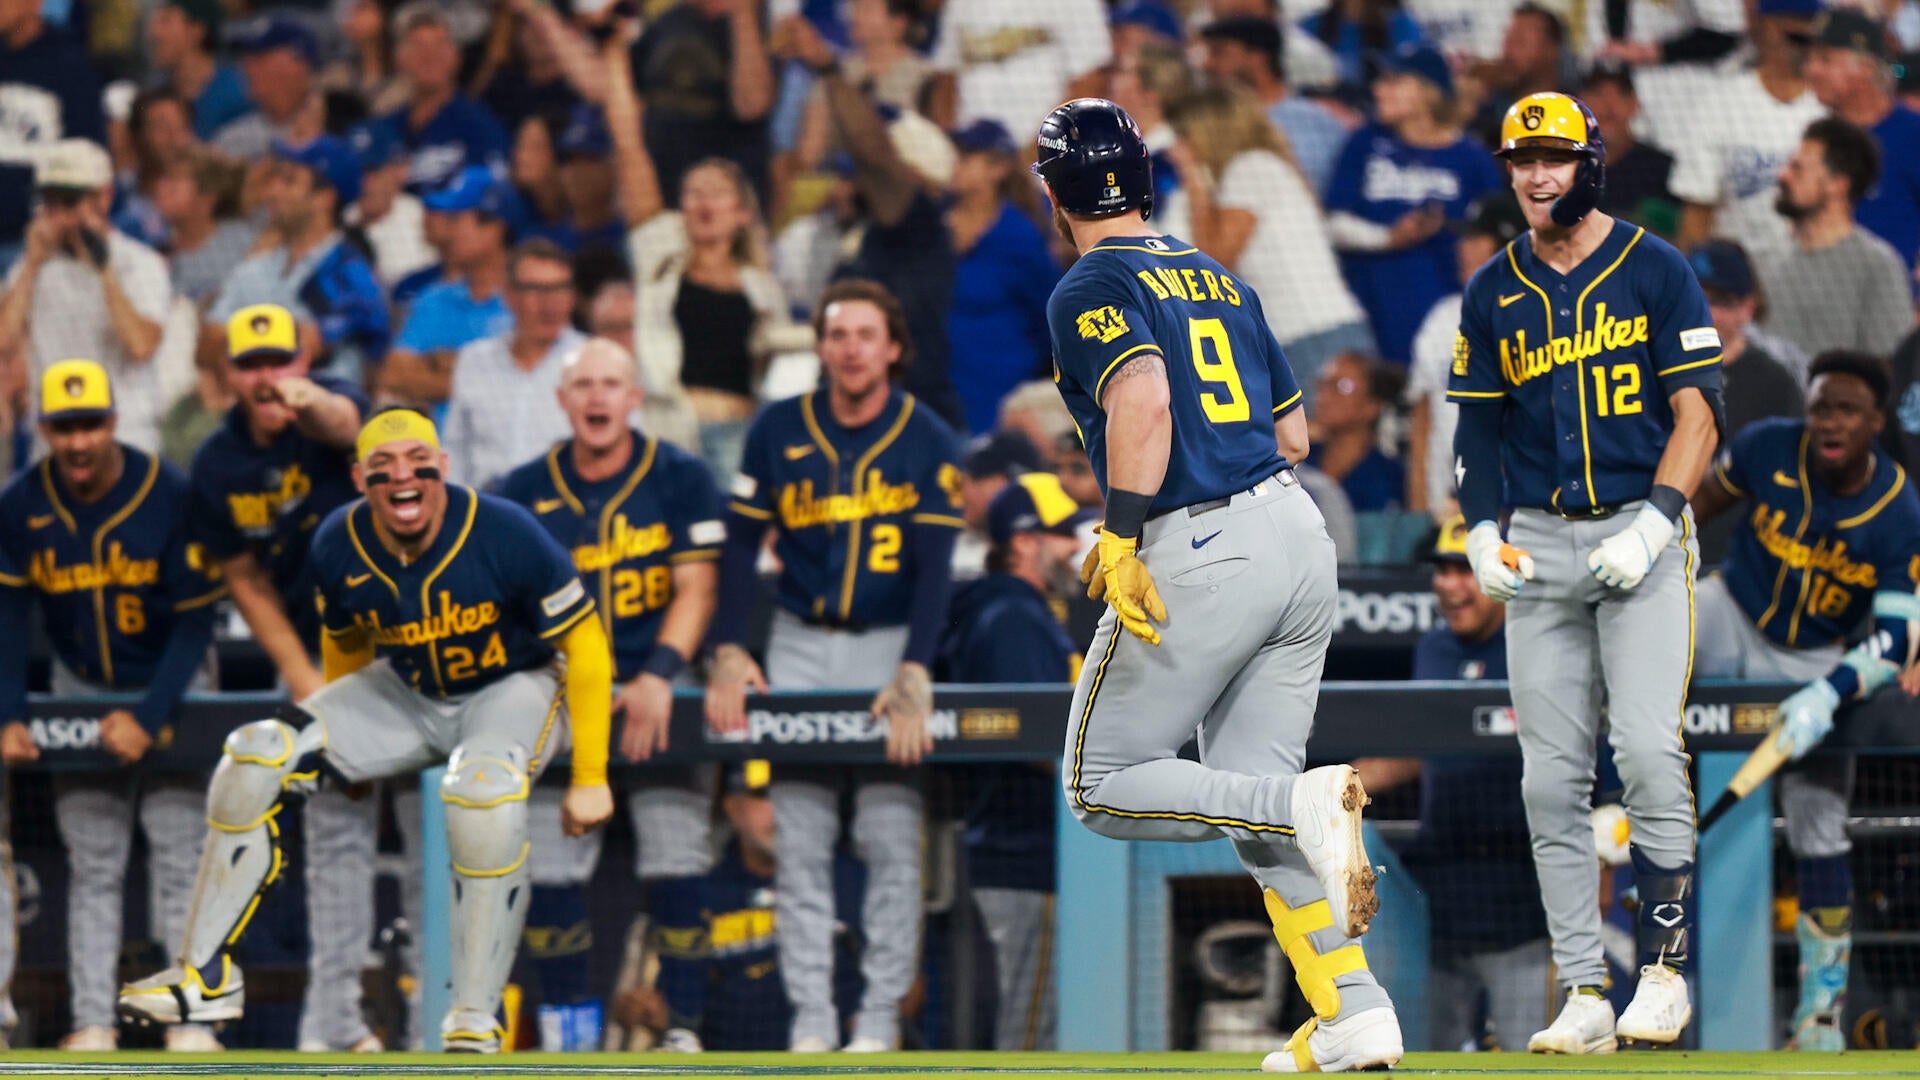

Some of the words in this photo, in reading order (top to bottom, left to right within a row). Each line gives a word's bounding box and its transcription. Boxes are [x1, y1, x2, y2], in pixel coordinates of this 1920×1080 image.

[1106, 172, 1115, 186] 9
[1500, 302, 1648, 387] Milwaukee
[1189, 317, 1250, 424] 9
[1592, 363, 1643, 417] 12
[867, 523, 902, 573] 2
[116, 594, 146, 634] 6
[613, 565, 672, 618] 28
[1807, 574, 1852, 617] 18
[443, 632, 508, 680] 24
